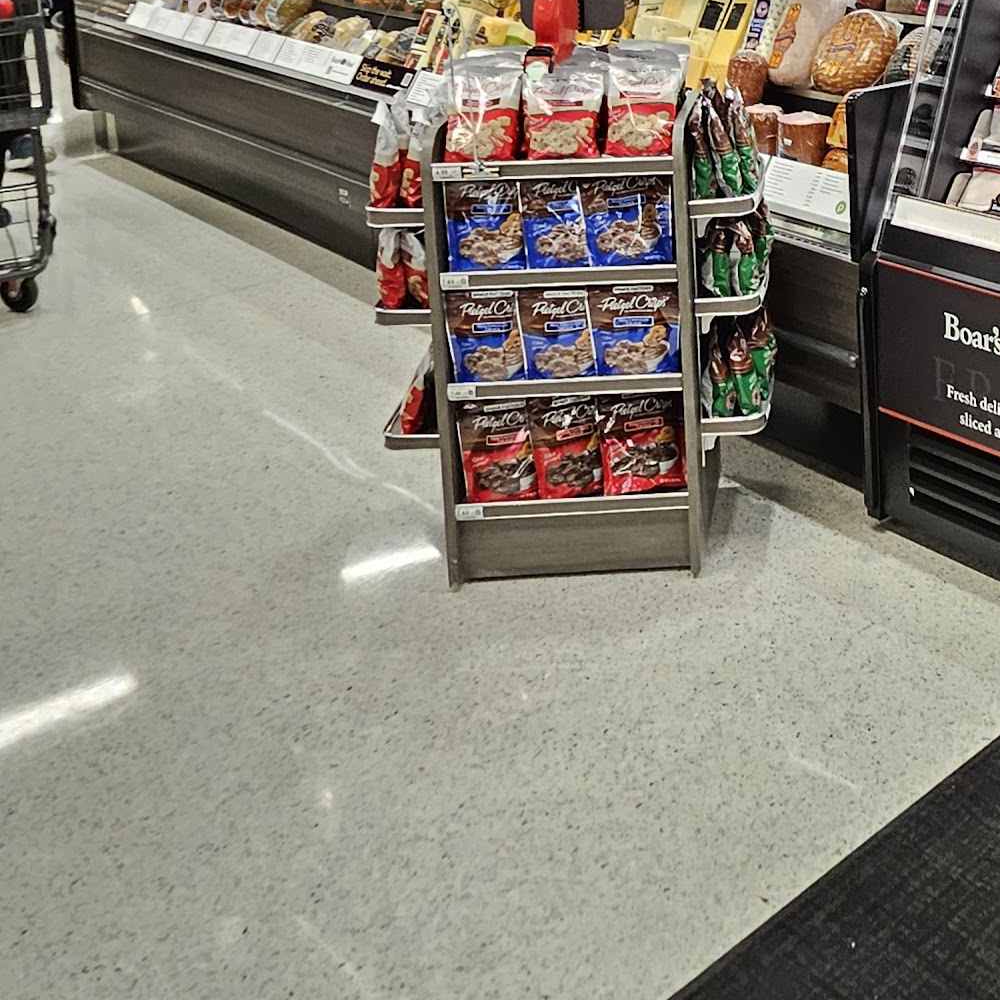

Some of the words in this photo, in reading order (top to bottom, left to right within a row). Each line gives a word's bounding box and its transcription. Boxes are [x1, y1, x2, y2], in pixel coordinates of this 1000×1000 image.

[460, 301, 493, 320] Pretzel
[532, 301, 565, 317] Pretzel
[601, 296, 633, 315] Pretzel
[635, 294, 667, 311] Crisps
[946, 384, 976, 407] Fresh
[980, 396, 1000, 416] deli
[611, 401, 642, 419] Pretzel
[473, 414, 505, 431] Pretzel
[959, 412, 991, 436] sliced
